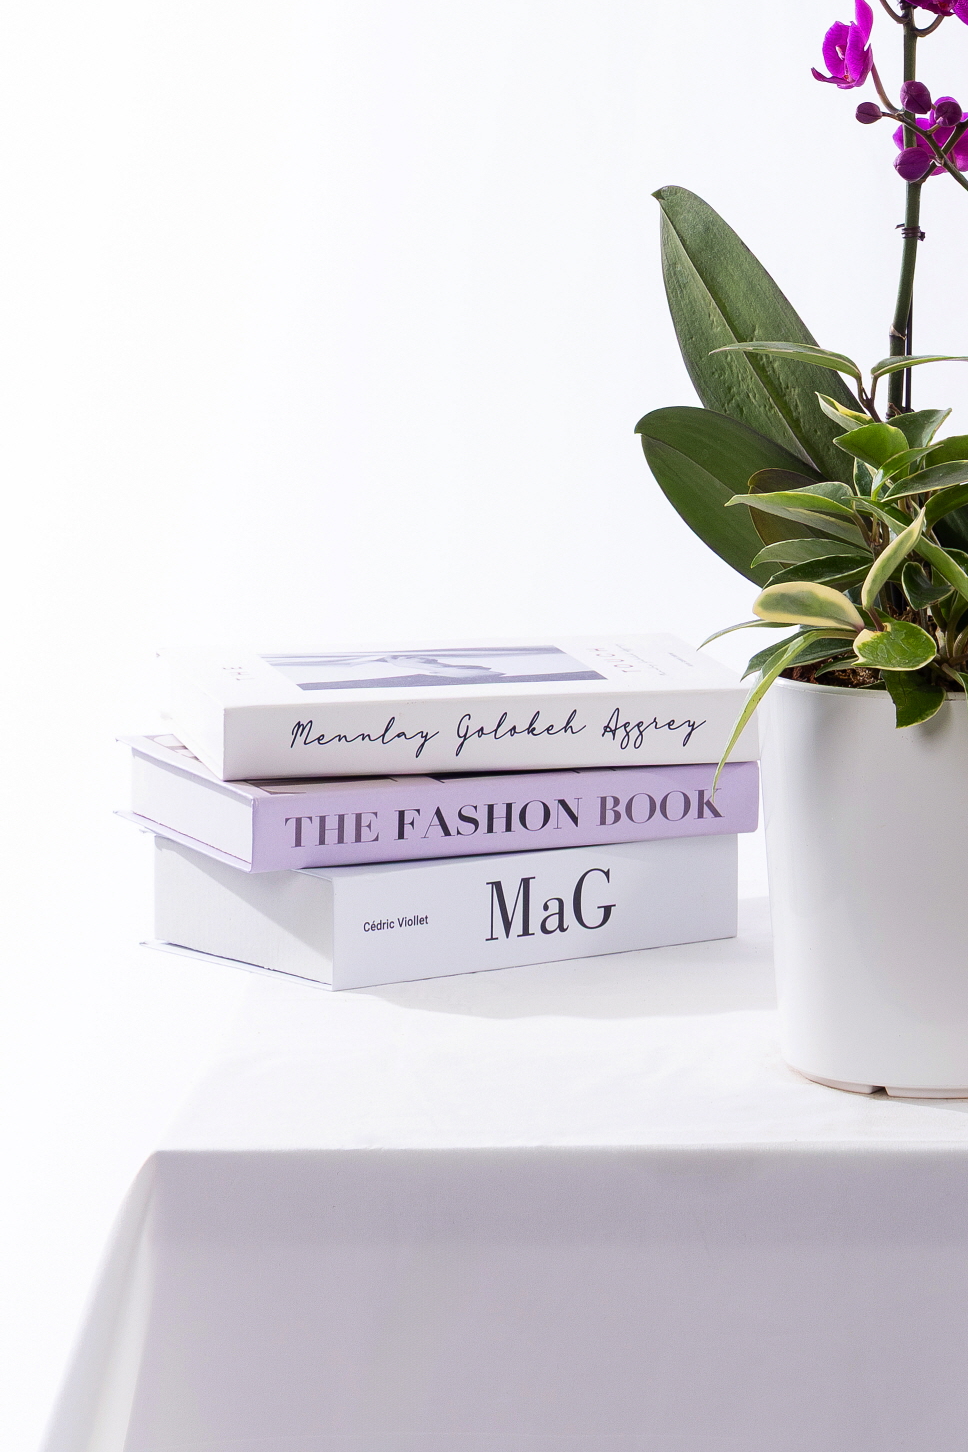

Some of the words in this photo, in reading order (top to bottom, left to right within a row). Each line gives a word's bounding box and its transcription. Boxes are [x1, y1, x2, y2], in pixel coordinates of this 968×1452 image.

[291, 716, 440, 758] Mennlay
[455, 708, 586, 757] Golokeh
[601, 707, 706, 750] Aggrey
[284, 811, 379, 848] THE
[393, 797, 583, 841] FASHON
[596, 787, 726, 827] BOOK
[363, 919, 395, 933] Cédric
[397, 914, 429, 928] Viollet
[485, 868, 617, 942] MaG
